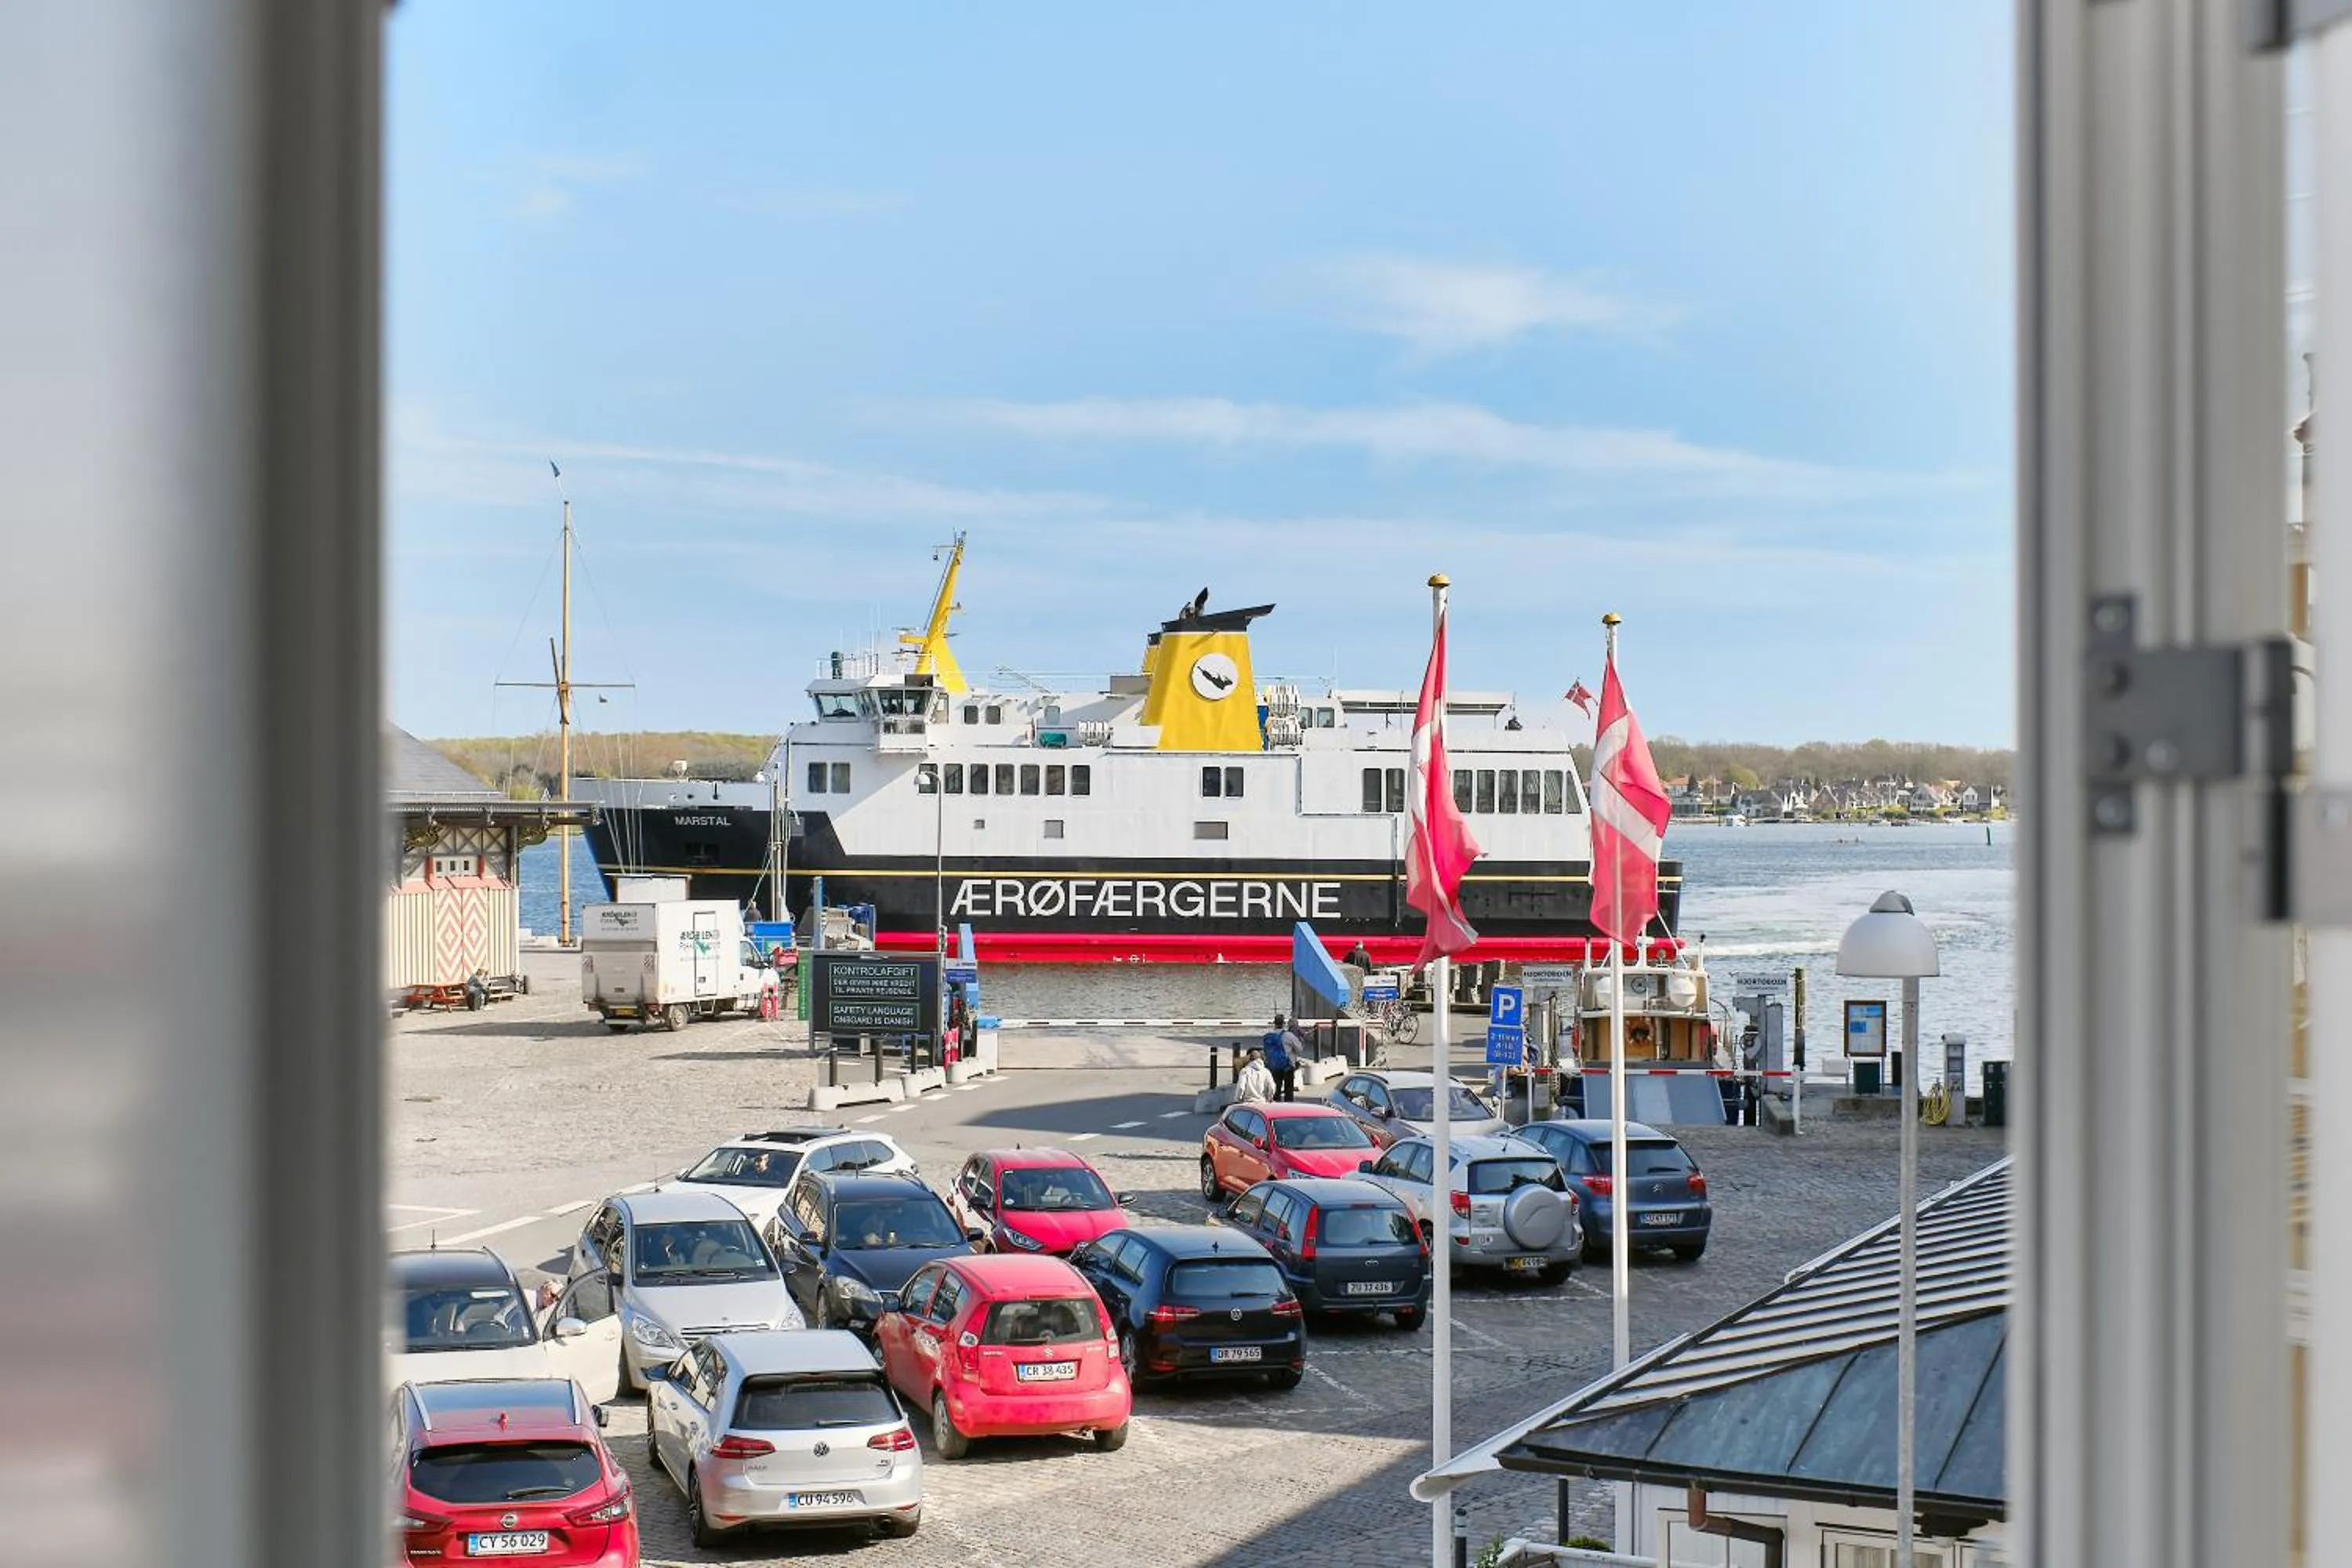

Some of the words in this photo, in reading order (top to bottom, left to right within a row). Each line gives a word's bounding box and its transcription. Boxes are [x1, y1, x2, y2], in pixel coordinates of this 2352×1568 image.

[674, 816, 732, 826] MARSTAL
[949, 879, 1342, 919] ÆRØFÆRGERNE
[833, 965, 915, 976] KONTROLAFGIFT
[833, 1006, 866, 1014] SAFETY
[867, 1007, 913, 1015] LANGUAGE
[1498, 994, 1515, 1019] P
[833, 1015, 873, 1025] ONBOARD
[884, 1017, 914, 1025] DANISH
[1231, 1349, 1243, 1359] 79
[1244, 1348, 1260, 1357] 565
[1055, 1365, 1073, 1375] 435
[797, 1495, 813, 1506] CU
[816, 1494, 830, 1505] 94
[832, 1493, 854, 1504] 596
[479, 1536, 498, 1549] CY
[501, 1534, 517, 1548] 56
[520, 1533, 546, 1547] 029
